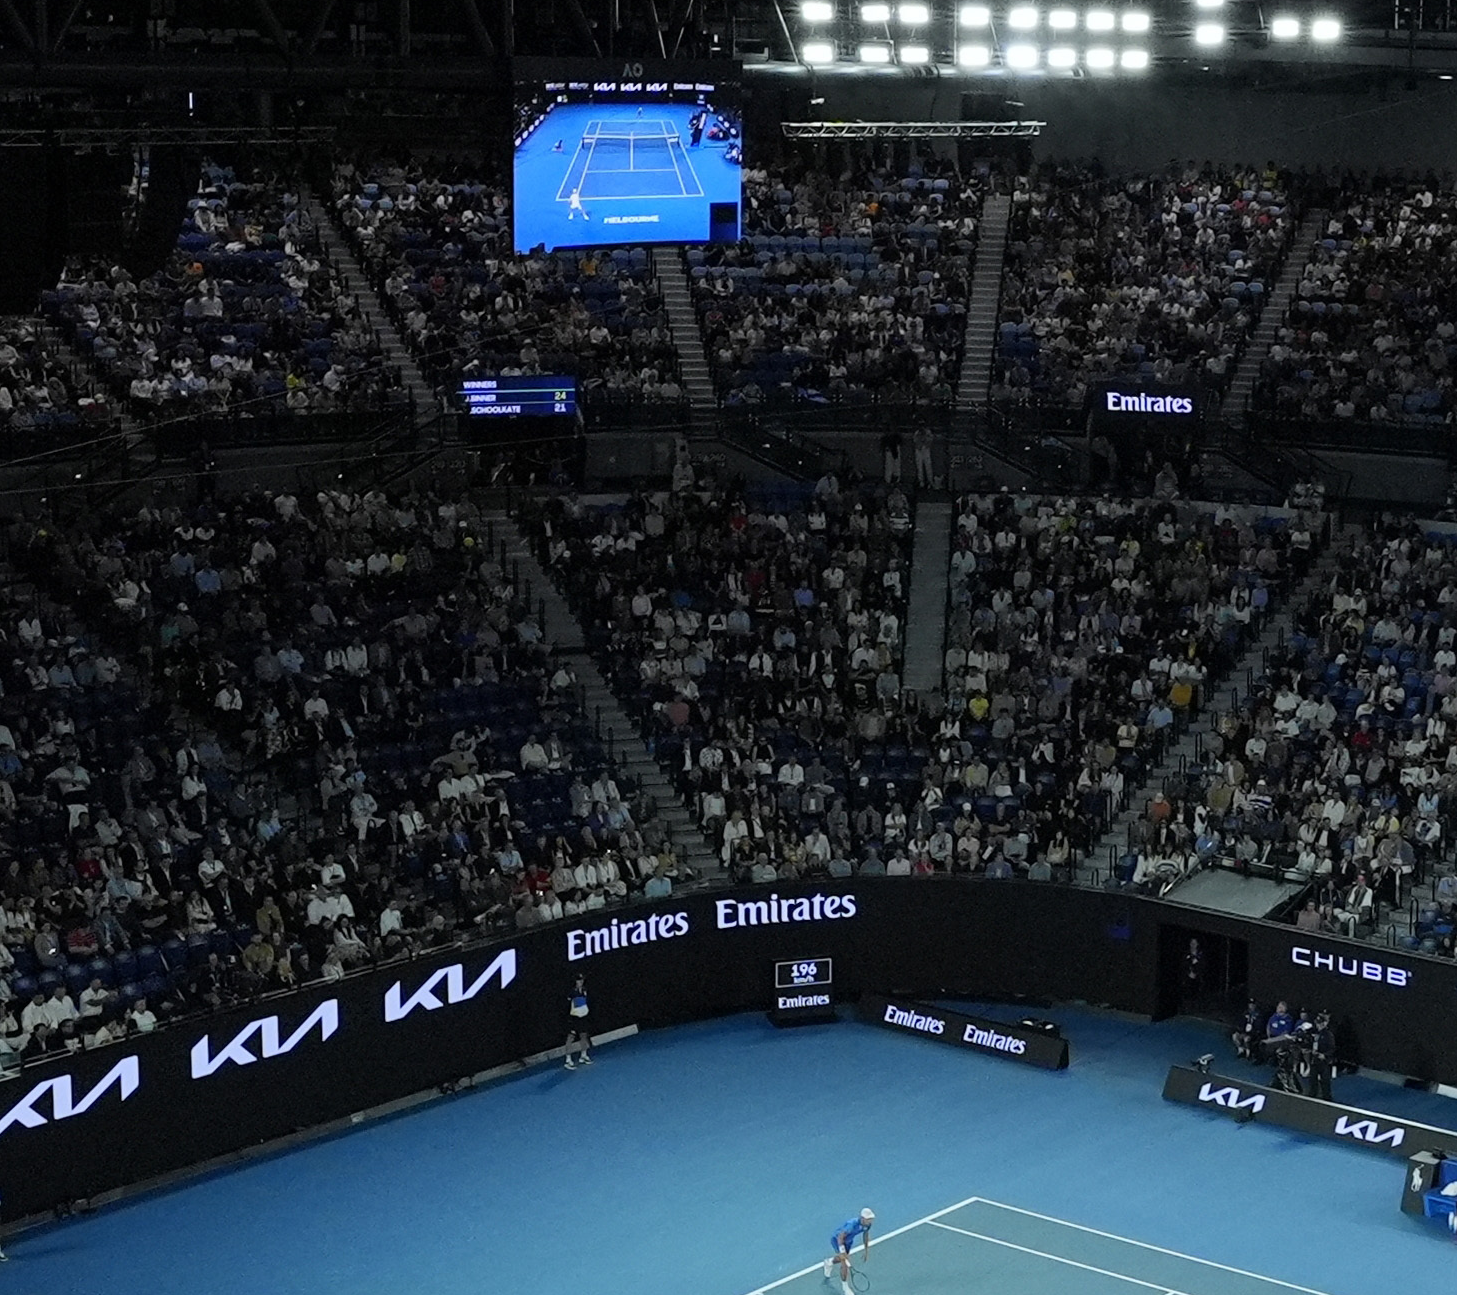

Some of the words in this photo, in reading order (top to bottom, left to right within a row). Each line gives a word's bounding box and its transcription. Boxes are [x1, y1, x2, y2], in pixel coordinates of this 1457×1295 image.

[463, 381, 497, 389] WINNERS
[554, 392, 566, 401] 24
[470, 405, 521, 415] .SCHOOLKATE
[554, 403, 566, 412] 21
[1107, 392, 1192, 413] Emirates
[716, 894, 856, 928] Emirates
[567, 912, 689, 961] Emirates
[791, 962, 817, 977] 196
[1291, 947, 1407, 987] CHUBB
[385, 949, 516, 1022] KIA
[778, 994, 830, 1010] Emirates
[885, 1005, 945, 1034] Emirates
[191, 999, 338, 1078] KIA
[963, 1024, 1026, 1055] Emirates
[1199, 1082, 1265, 1113] KIA
[1334, 1115, 1405, 1147] KIA
